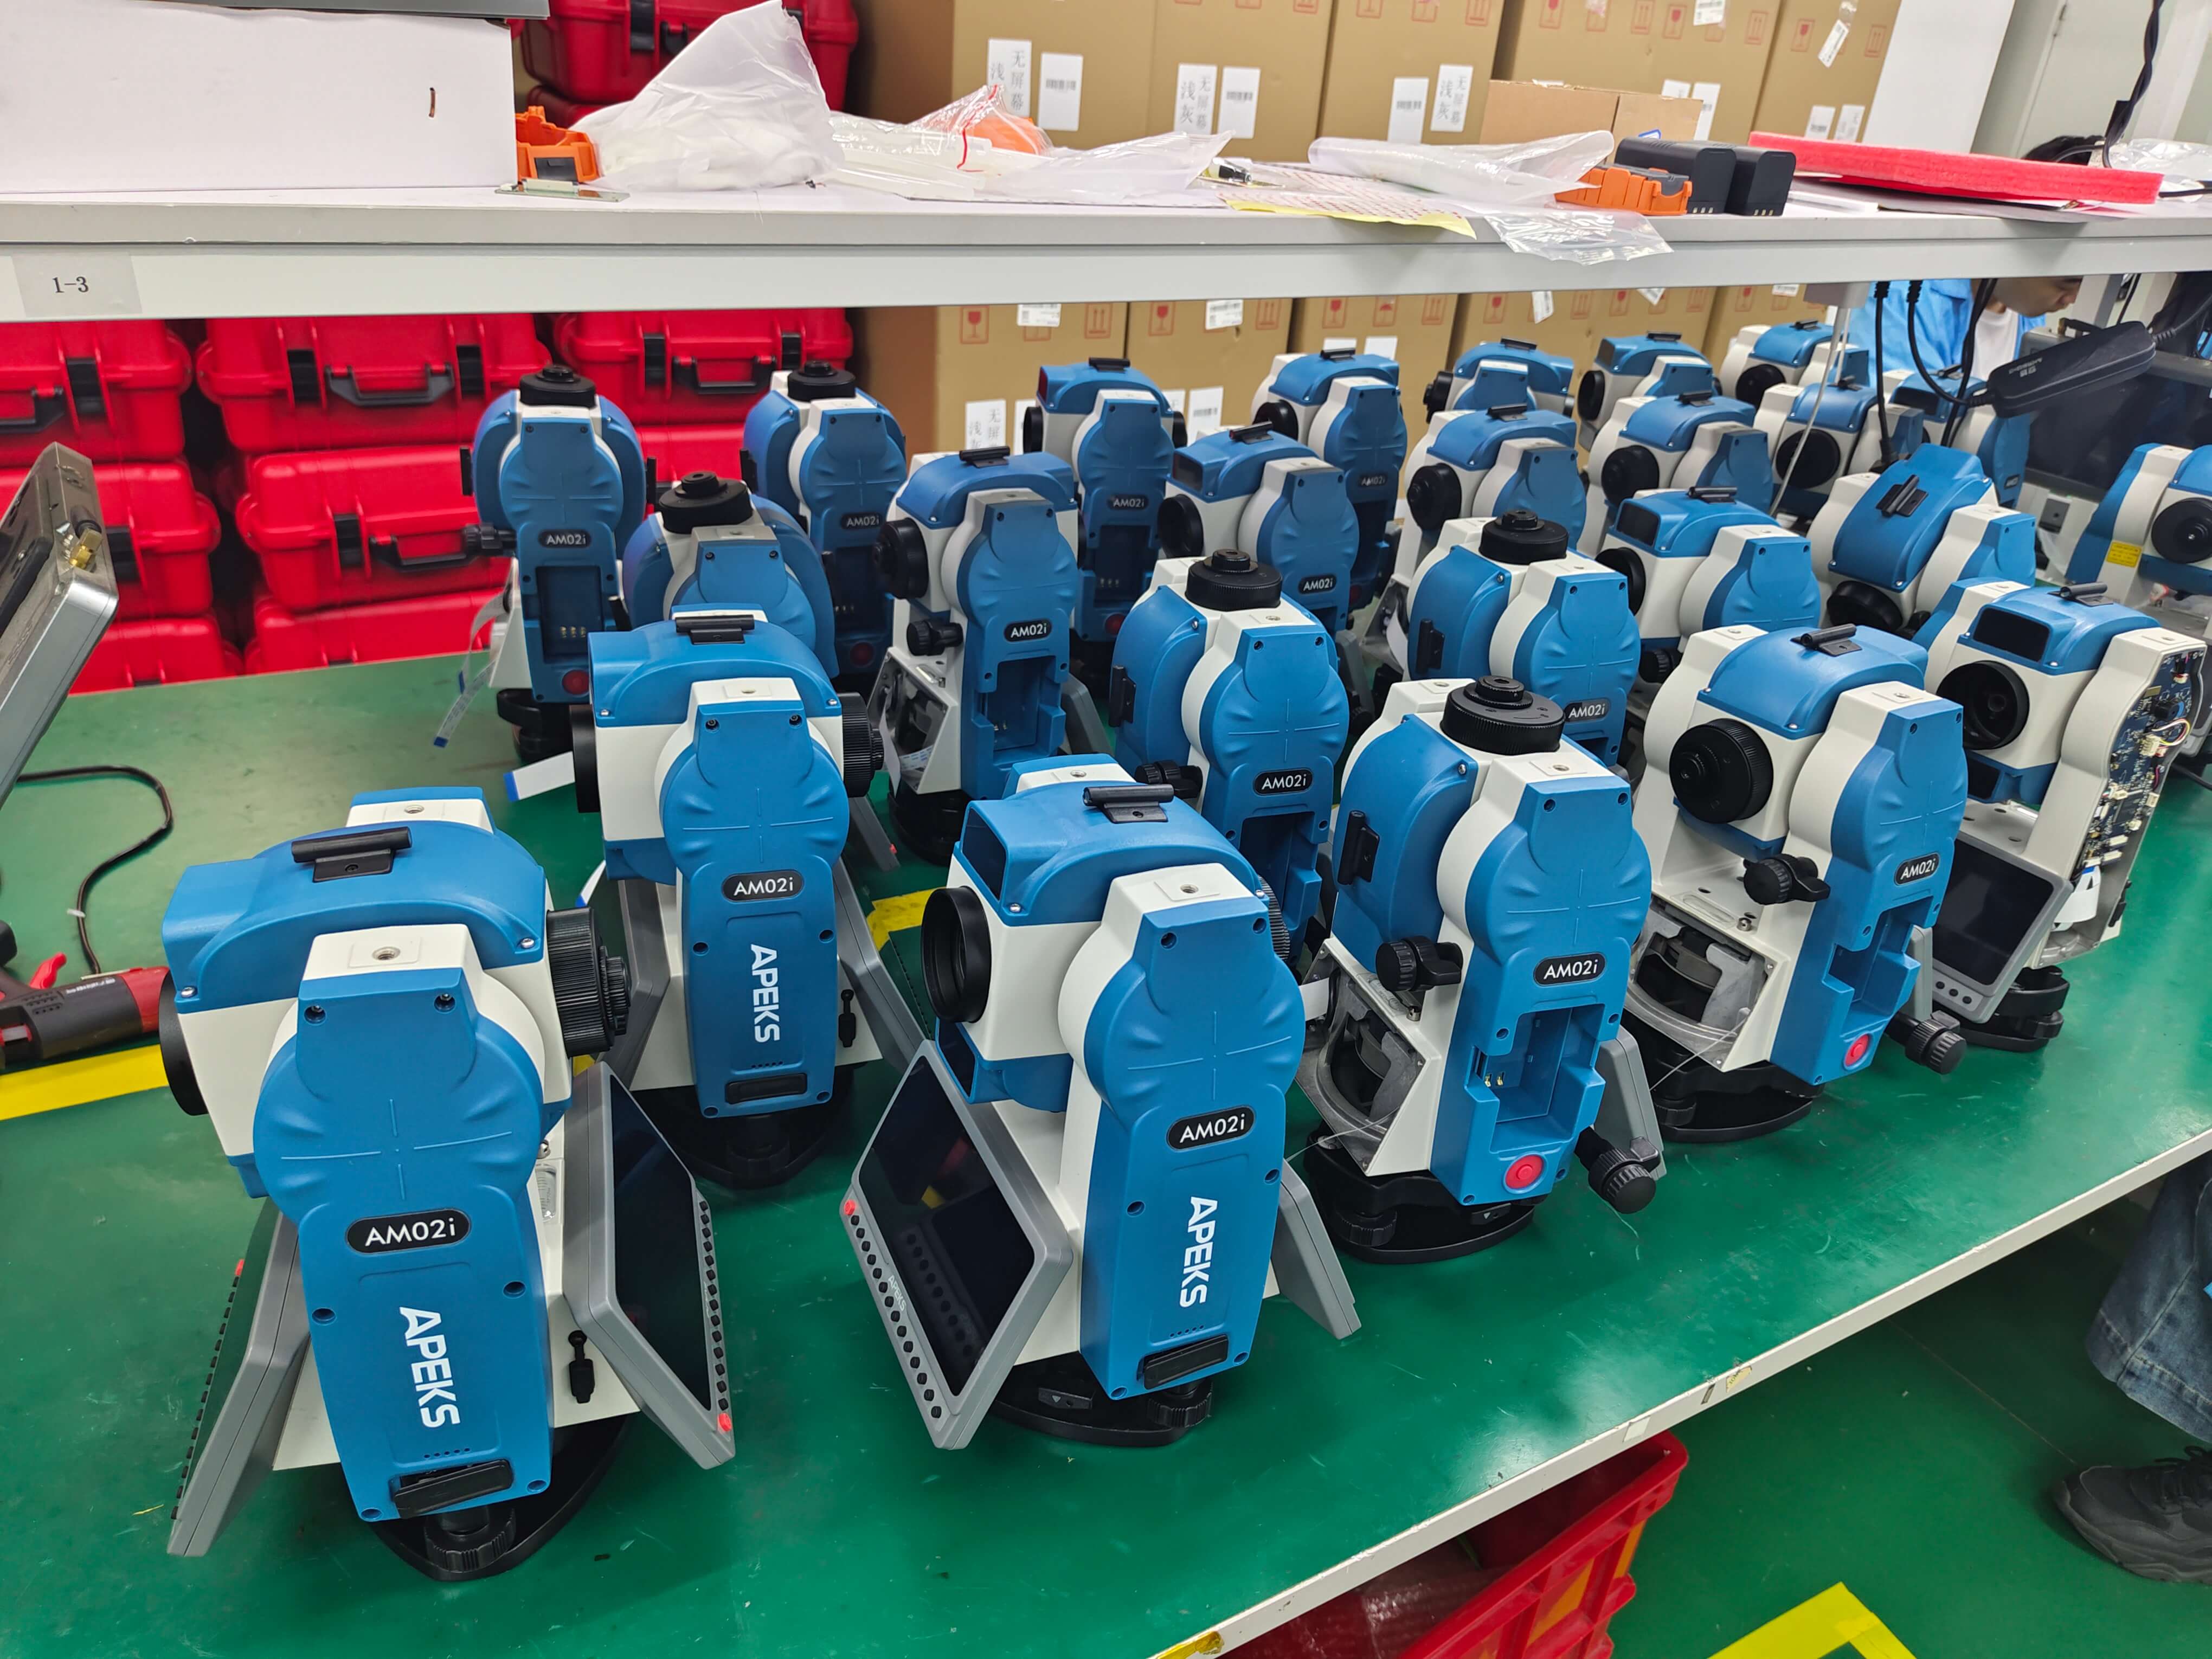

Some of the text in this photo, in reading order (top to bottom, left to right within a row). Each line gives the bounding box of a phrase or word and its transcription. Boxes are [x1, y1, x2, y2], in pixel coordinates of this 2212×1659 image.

[52, 276, 89, 293] 1-3
[1113, 498, 1145, 508] AM02i
[847, 515, 879, 528] AM02i
[546, 533, 586, 545] AM02i
[1303, 577, 1334, 591] AM02i
[1011, 623, 1047, 638] AM02i
[1568, 703, 1605, 719] AM02i
[1261, 774, 1307, 790] AM02i
[1900, 858, 1936, 880] AM02i
[734, 877, 793, 896] AM02i
[1544, 959, 1598, 980] AM02i
[751, 944, 780, 1043] APEKS
[1179, 1113, 1245, 1143] AM02i
[365, 1217, 456, 1247] AM02i
[1179, 1196, 1218, 1308] APEKS
[888, 1275, 906, 1311] APEKS
[399, 1307, 461, 1428] APEKS
